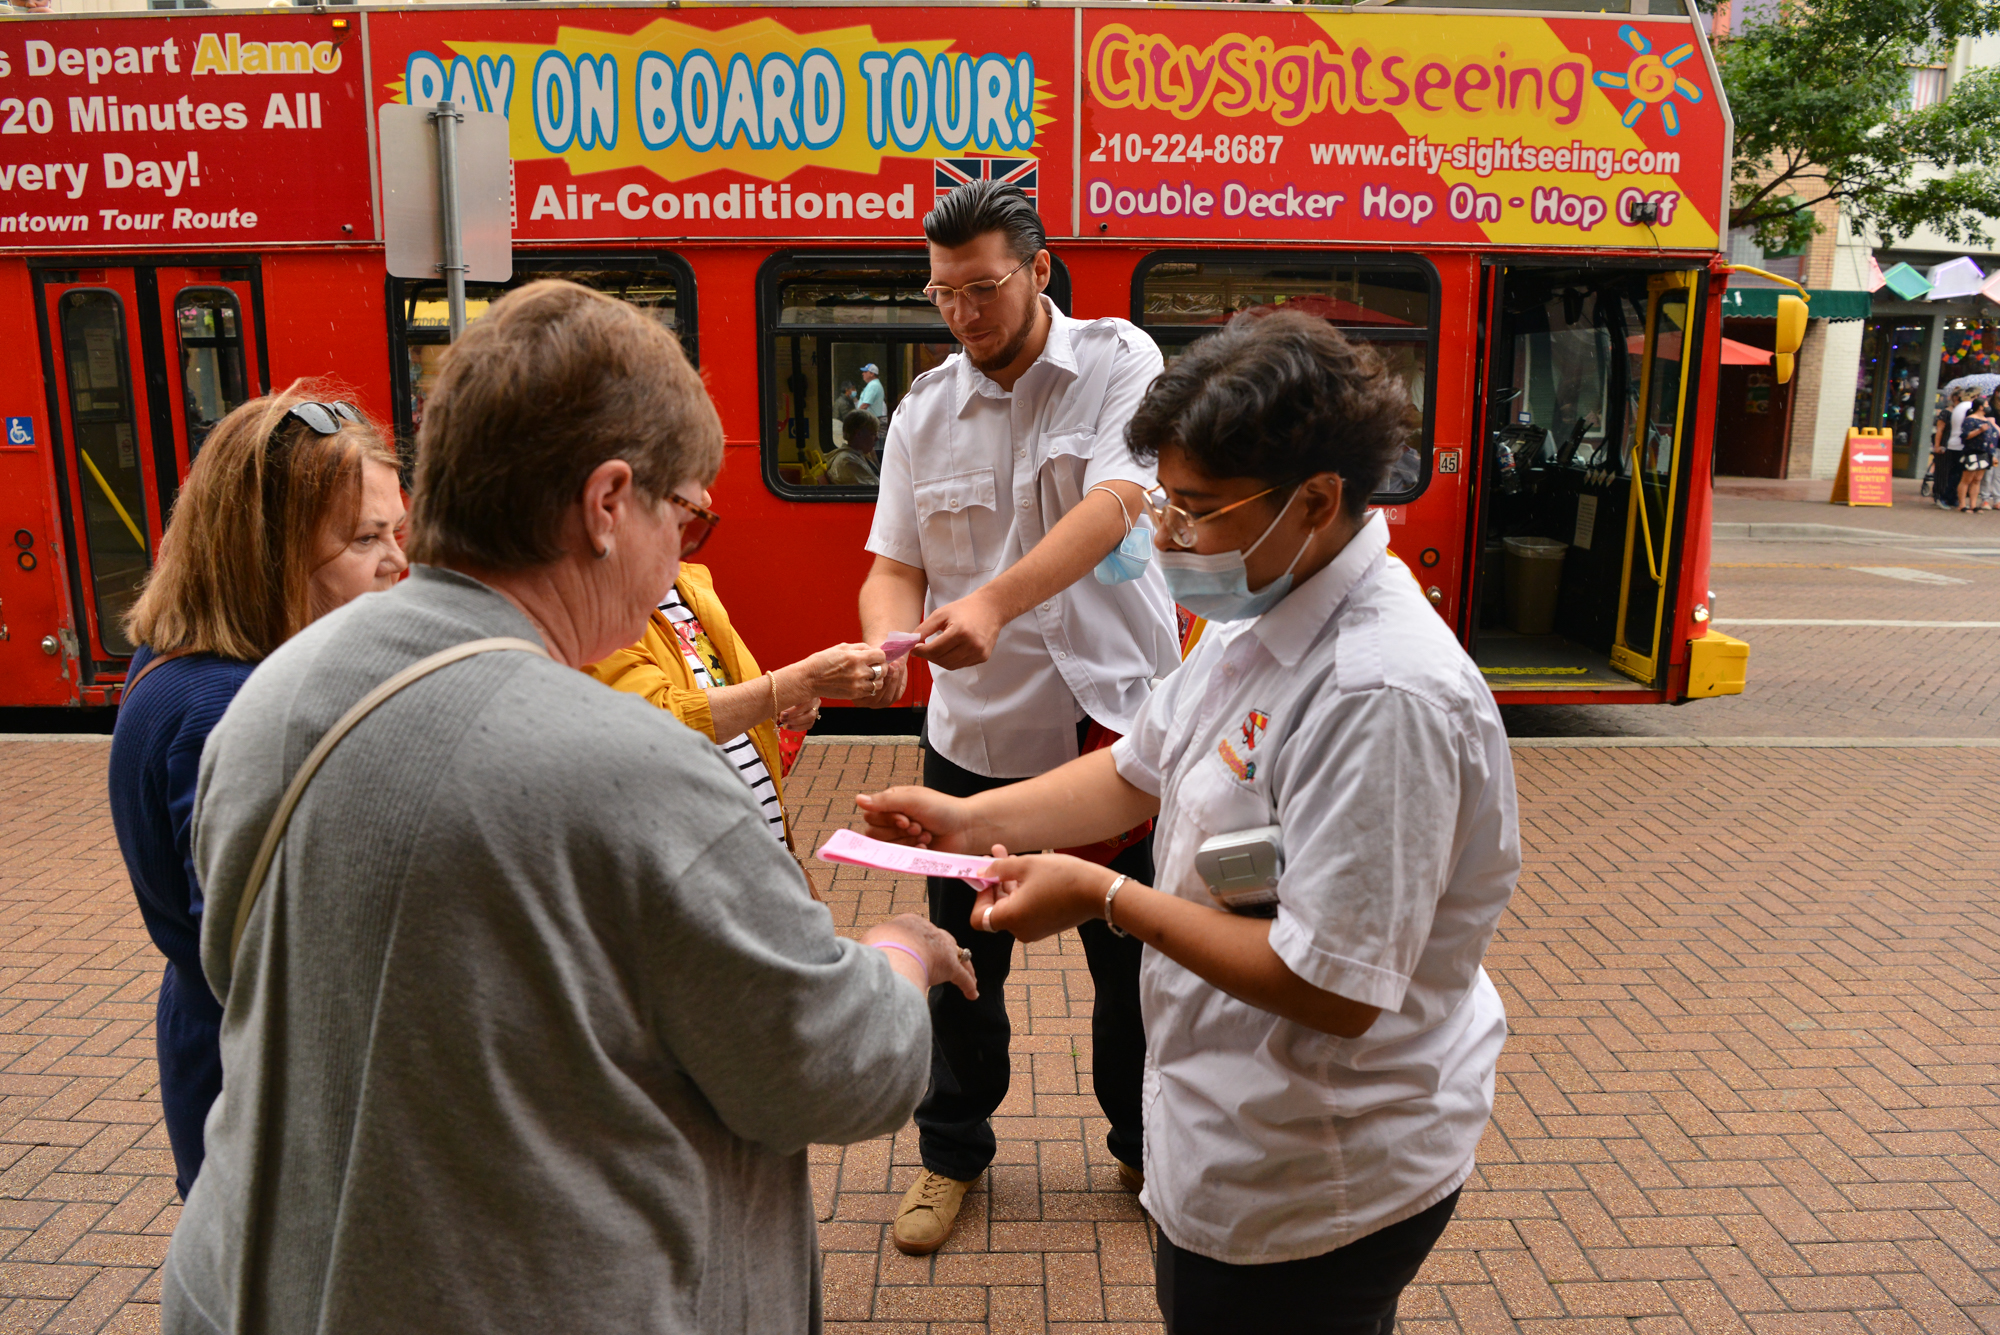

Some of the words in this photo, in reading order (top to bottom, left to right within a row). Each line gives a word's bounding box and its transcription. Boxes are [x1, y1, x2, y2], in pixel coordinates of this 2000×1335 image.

[26, 38, 180, 83] Depart
[192, 33, 342, 75] Alamo
[1089, 23, 1592, 129] CitySightseeing
[0, 97, 53, 134] 20
[69, 94, 248, 133] Minutes
[263, 93, 322, 129] All
[532, 50, 617, 152] ON
[635, 48, 846, 152] BOARD
[860, 51, 1034, 150] TOUR!
[1089, 134, 1283, 164] 210-224-8687
[1310, 136, 1680, 179] www.city-sightseeing.com
[103, 152, 200, 195] Day!
[0, 212, 88, 232] ntown
[99, 209, 166, 230] Tour
[172, 208, 258, 229] Route
[530, 184, 914, 220] Air-Conditioned
[1088, 179, 1216, 218] Double
[1222, 182, 1344, 220] Decker
[1362, 185, 1434, 224] Hop
[1447, 187, 1502, 222] On
[1531, 189, 1607, 229] Hop
[1441, 457, 1456, 471] 45
[1852, 466, 1890, 474] WELCOME
[1855, 475, 1886, 483] CENTER
